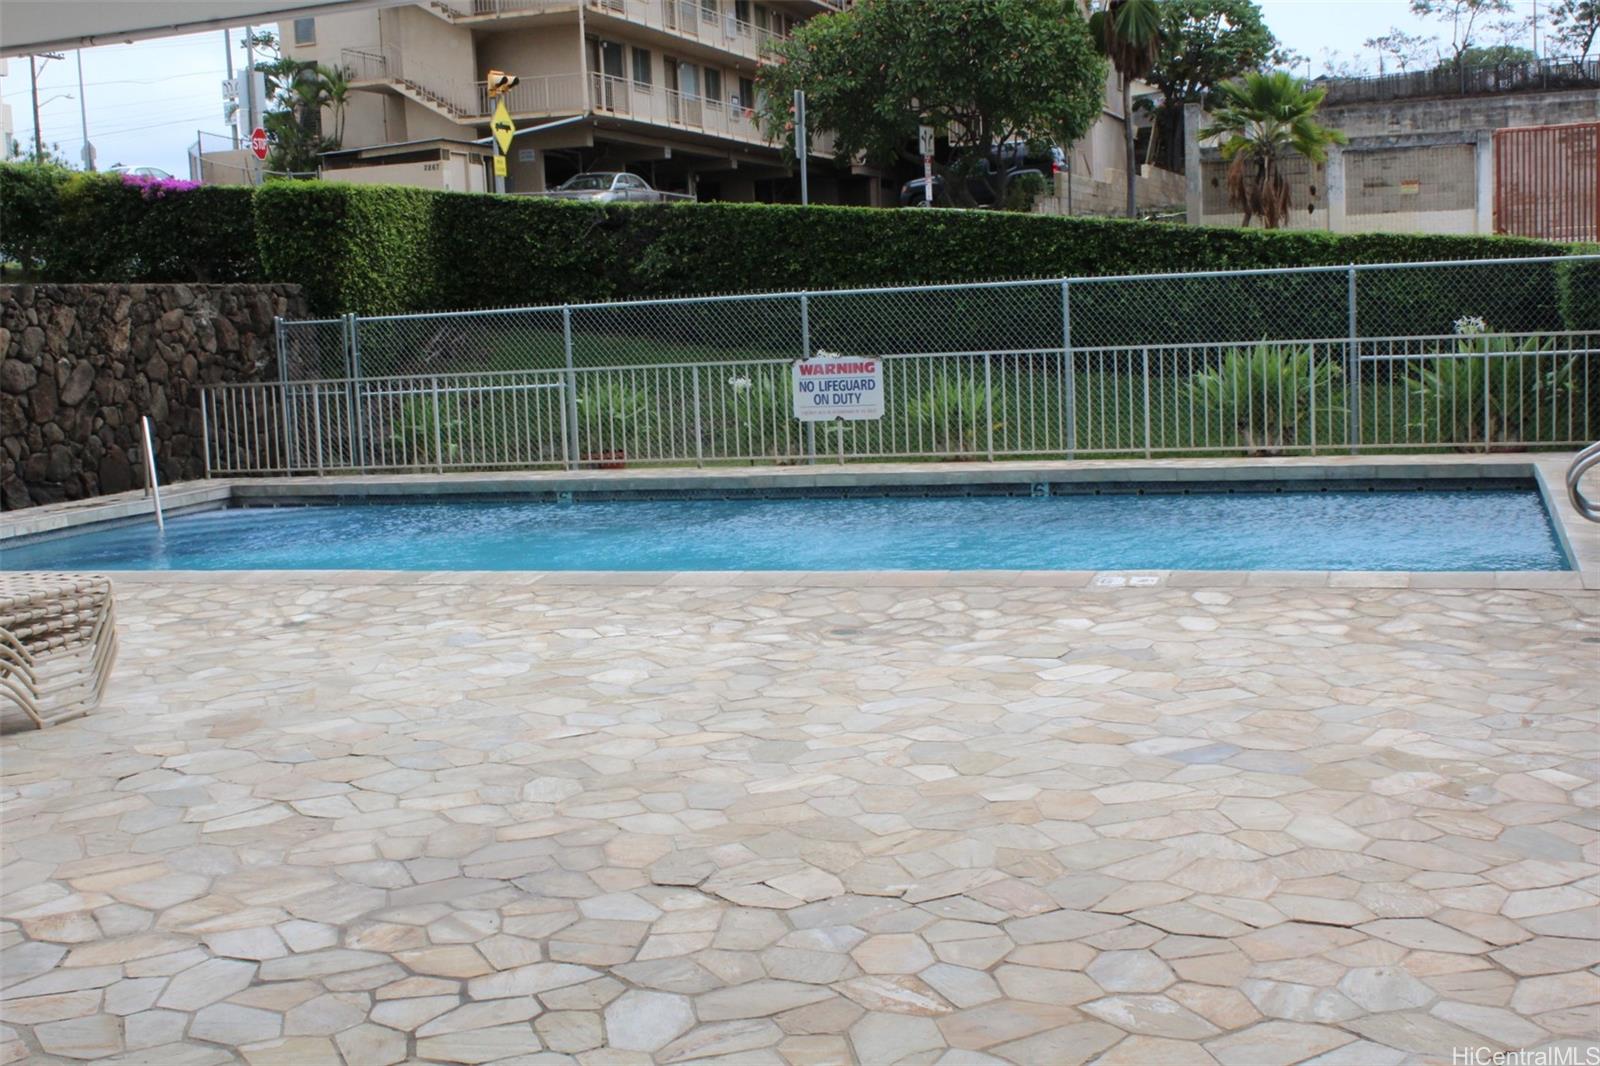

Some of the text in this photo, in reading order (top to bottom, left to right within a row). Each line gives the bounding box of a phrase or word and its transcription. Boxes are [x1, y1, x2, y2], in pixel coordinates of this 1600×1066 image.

[252, 137, 267, 150] STOP
[799, 362, 875, 376] WARNING
[799, 379, 876, 393] NO LIFEGUARD
[814, 393, 861, 405] ON DUTY
